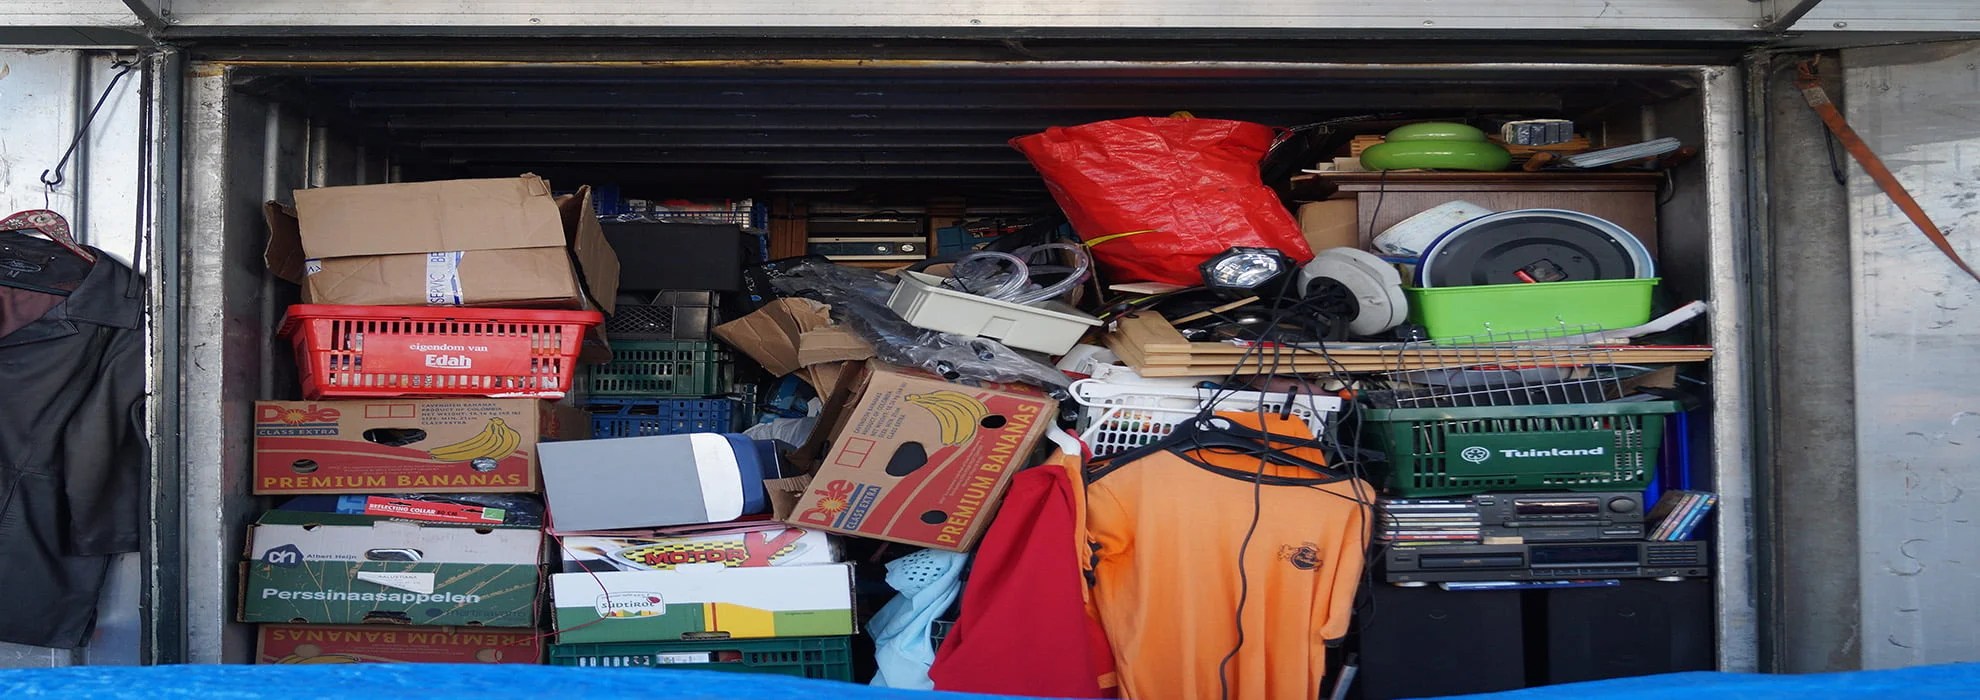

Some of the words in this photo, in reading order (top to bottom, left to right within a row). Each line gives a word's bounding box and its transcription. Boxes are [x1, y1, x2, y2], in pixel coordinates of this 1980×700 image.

[409, 343, 465, 352] eigendom
[426, 354, 472, 369] Edah
[257, 404, 340, 425] Dole
[1500, 447, 1604, 458] Tuinland
[264, 476, 386, 488] PREMIUM
[397, 474, 521, 487] BANANAS
[937, 475, 995, 543] PREMIUM
[980, 404, 1039, 473] BANANAS
[409, 507, 436, 515] COLLAR
[798, 480, 855, 527] Dole
[846, 508, 865, 529] CLASS
[859, 486, 880, 508] EXTRA
[644, 549, 746, 566] MOTOR
[261, 588, 481, 605] Perssinaasappelen
[273, 629, 396, 643] BANANAS
[409, 632, 531, 647] PREMIUM
